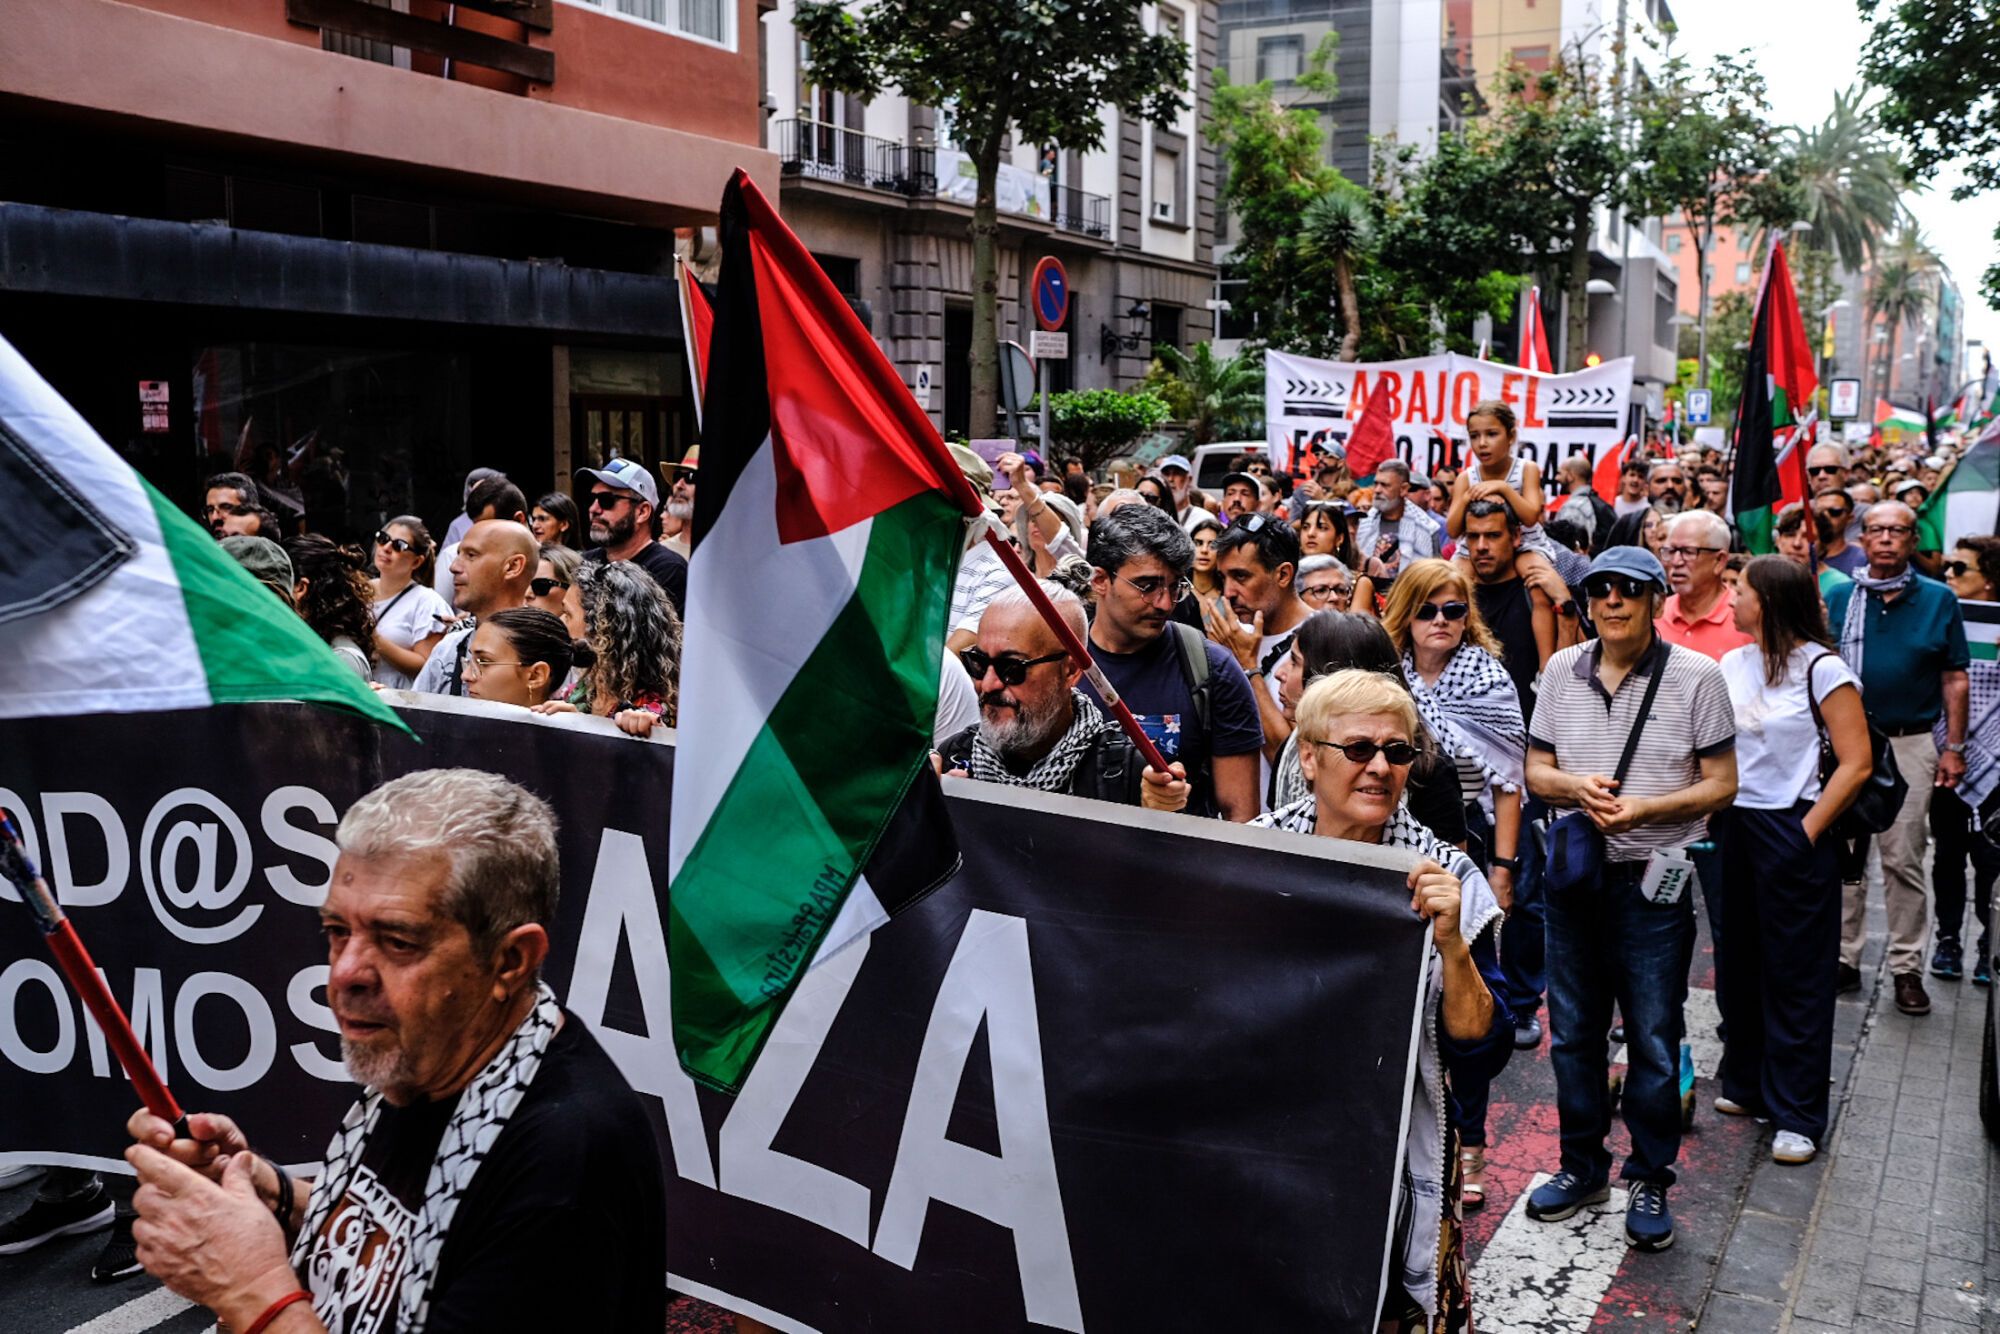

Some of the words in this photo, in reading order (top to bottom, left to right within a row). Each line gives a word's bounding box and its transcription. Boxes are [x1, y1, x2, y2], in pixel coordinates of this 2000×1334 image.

[1345, 369, 1480, 425] ABAJO
[1502, 372, 1545, 428] EL
[566, 827, 1086, 1334] AZA
